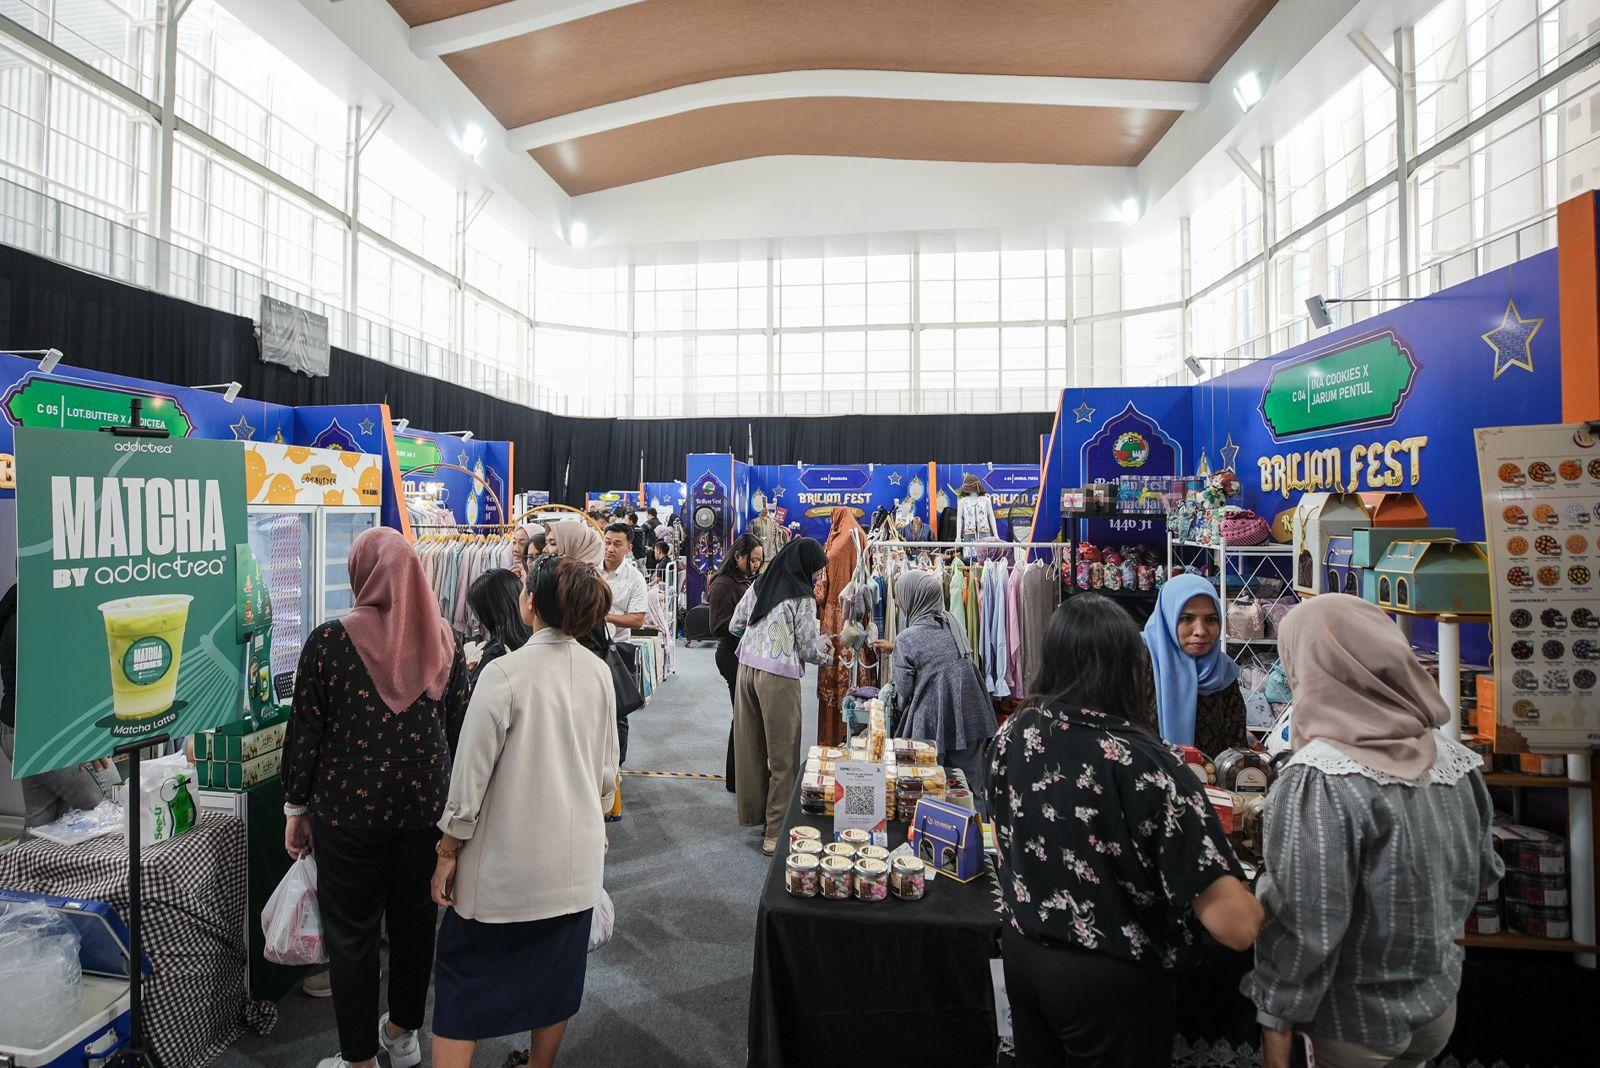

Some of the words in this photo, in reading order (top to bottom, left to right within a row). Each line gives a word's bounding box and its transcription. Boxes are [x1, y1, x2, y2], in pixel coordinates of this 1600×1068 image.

[1311, 376, 1325, 390] INA
[1325, 366, 1361, 386] COOKIES
[1362, 364, 1369, 378] X
[1292, 391, 1297, 402] C
[1298, 389, 1306, 401] 04
[1311, 389, 1338, 406] JARUM
[1339, 381, 1373, 400] PENTUL
[36, 403, 44, 414] C
[46, 404, 59, 416] 05
[66, 407, 118, 424] LOT.BUTTER
[120, 415, 126, 424] X
[1257, 446, 1345, 499] BRILIAN
[1347, 435, 1428, 493] FEST
[797, 492, 842, 506] BRILIAN
[843, 492, 872, 505] FEST
[51, 475, 227, 560] MATCHA
[1109, 518, 1137, 531] 1440
[53, 567, 89, 589] BY
[113, 724, 151, 734] Matcha
[153, 712, 176, 729] Latte
